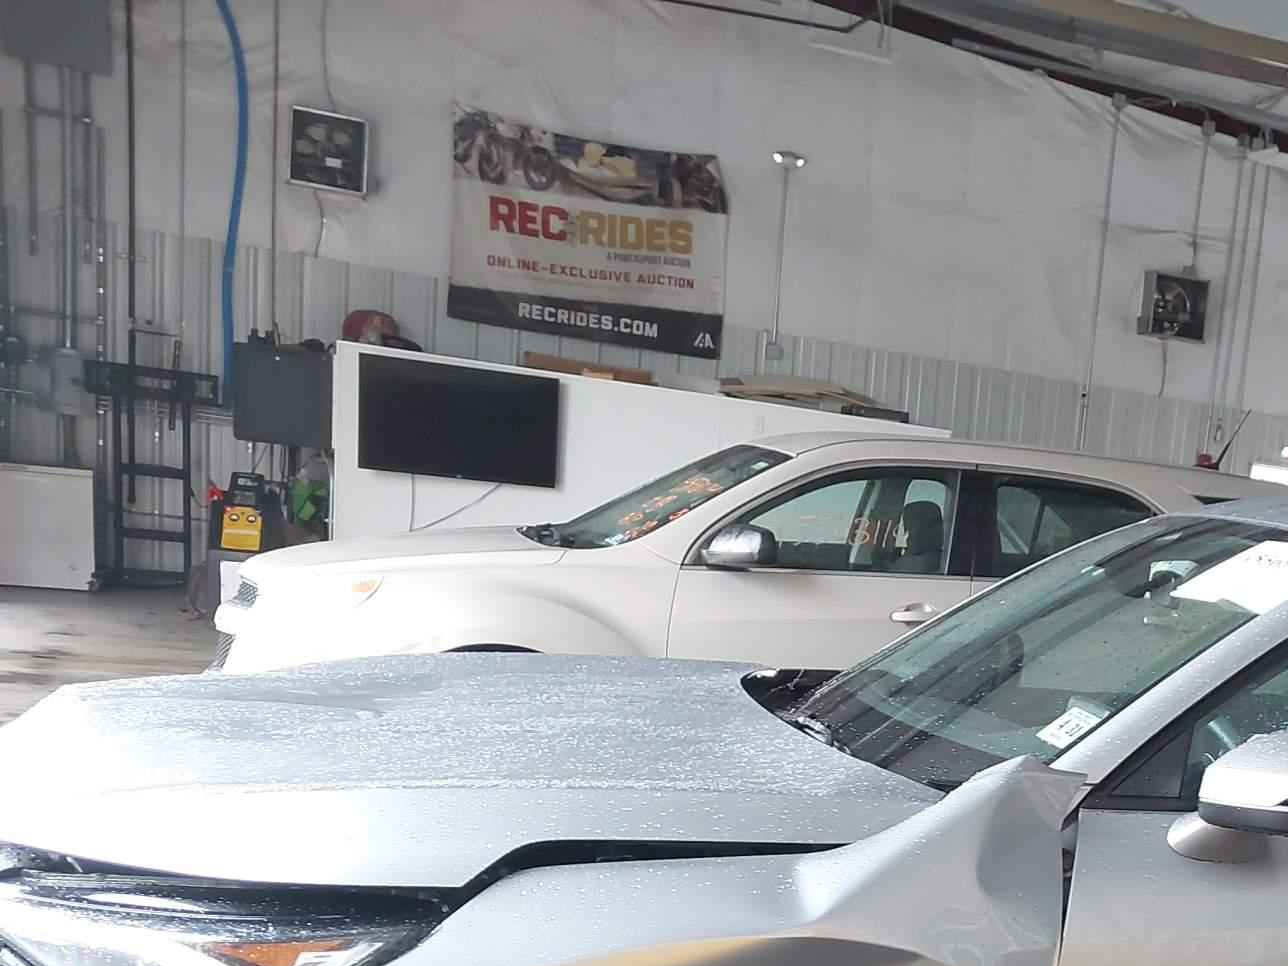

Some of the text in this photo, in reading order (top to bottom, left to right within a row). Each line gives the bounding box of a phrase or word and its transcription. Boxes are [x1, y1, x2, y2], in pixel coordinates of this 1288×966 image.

[489, 195, 693, 255] REC RIDES
[487, 254, 631, 283] ONLINE-EXCLUSIVE
[637, 271, 695, 289] AUCTION
[518, 302, 659, 338] RECRIDES.COM
